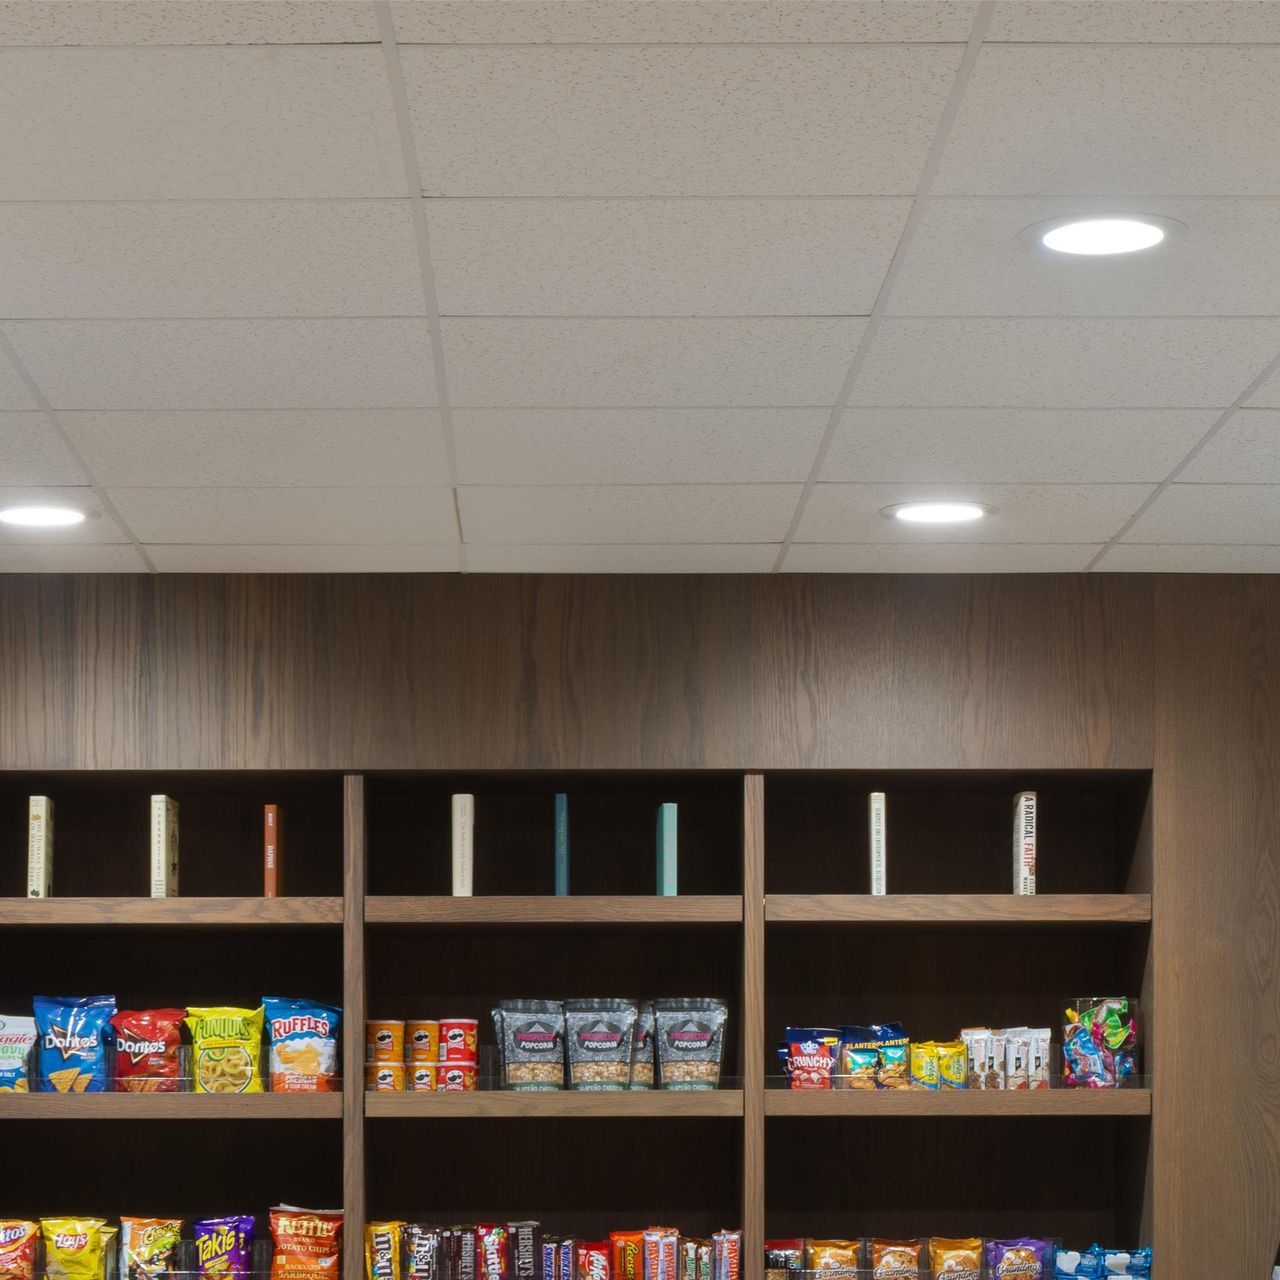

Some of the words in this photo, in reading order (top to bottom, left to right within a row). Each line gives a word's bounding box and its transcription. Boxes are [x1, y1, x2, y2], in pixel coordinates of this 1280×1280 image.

[1024, 804, 1034, 840] RADICAL
[1024, 843, 1034, 867] FAITH
[271, 1017, 329, 1038] RUFFLES
[45, 1034, 98, 1049] Doritos
[116, 1038, 166, 1054] Doritos
[521, 1041, 554, 1049] POPCORN
[583, 1041, 618, 1049] POPCORN
[673, 1041, 707, 1049] POPCORN
[787, 1056, 834, 1071] CRUNCHY
[196, 1228, 236, 1266] Takis
[518, 1228, 534, 1277] HERSHEY'S
